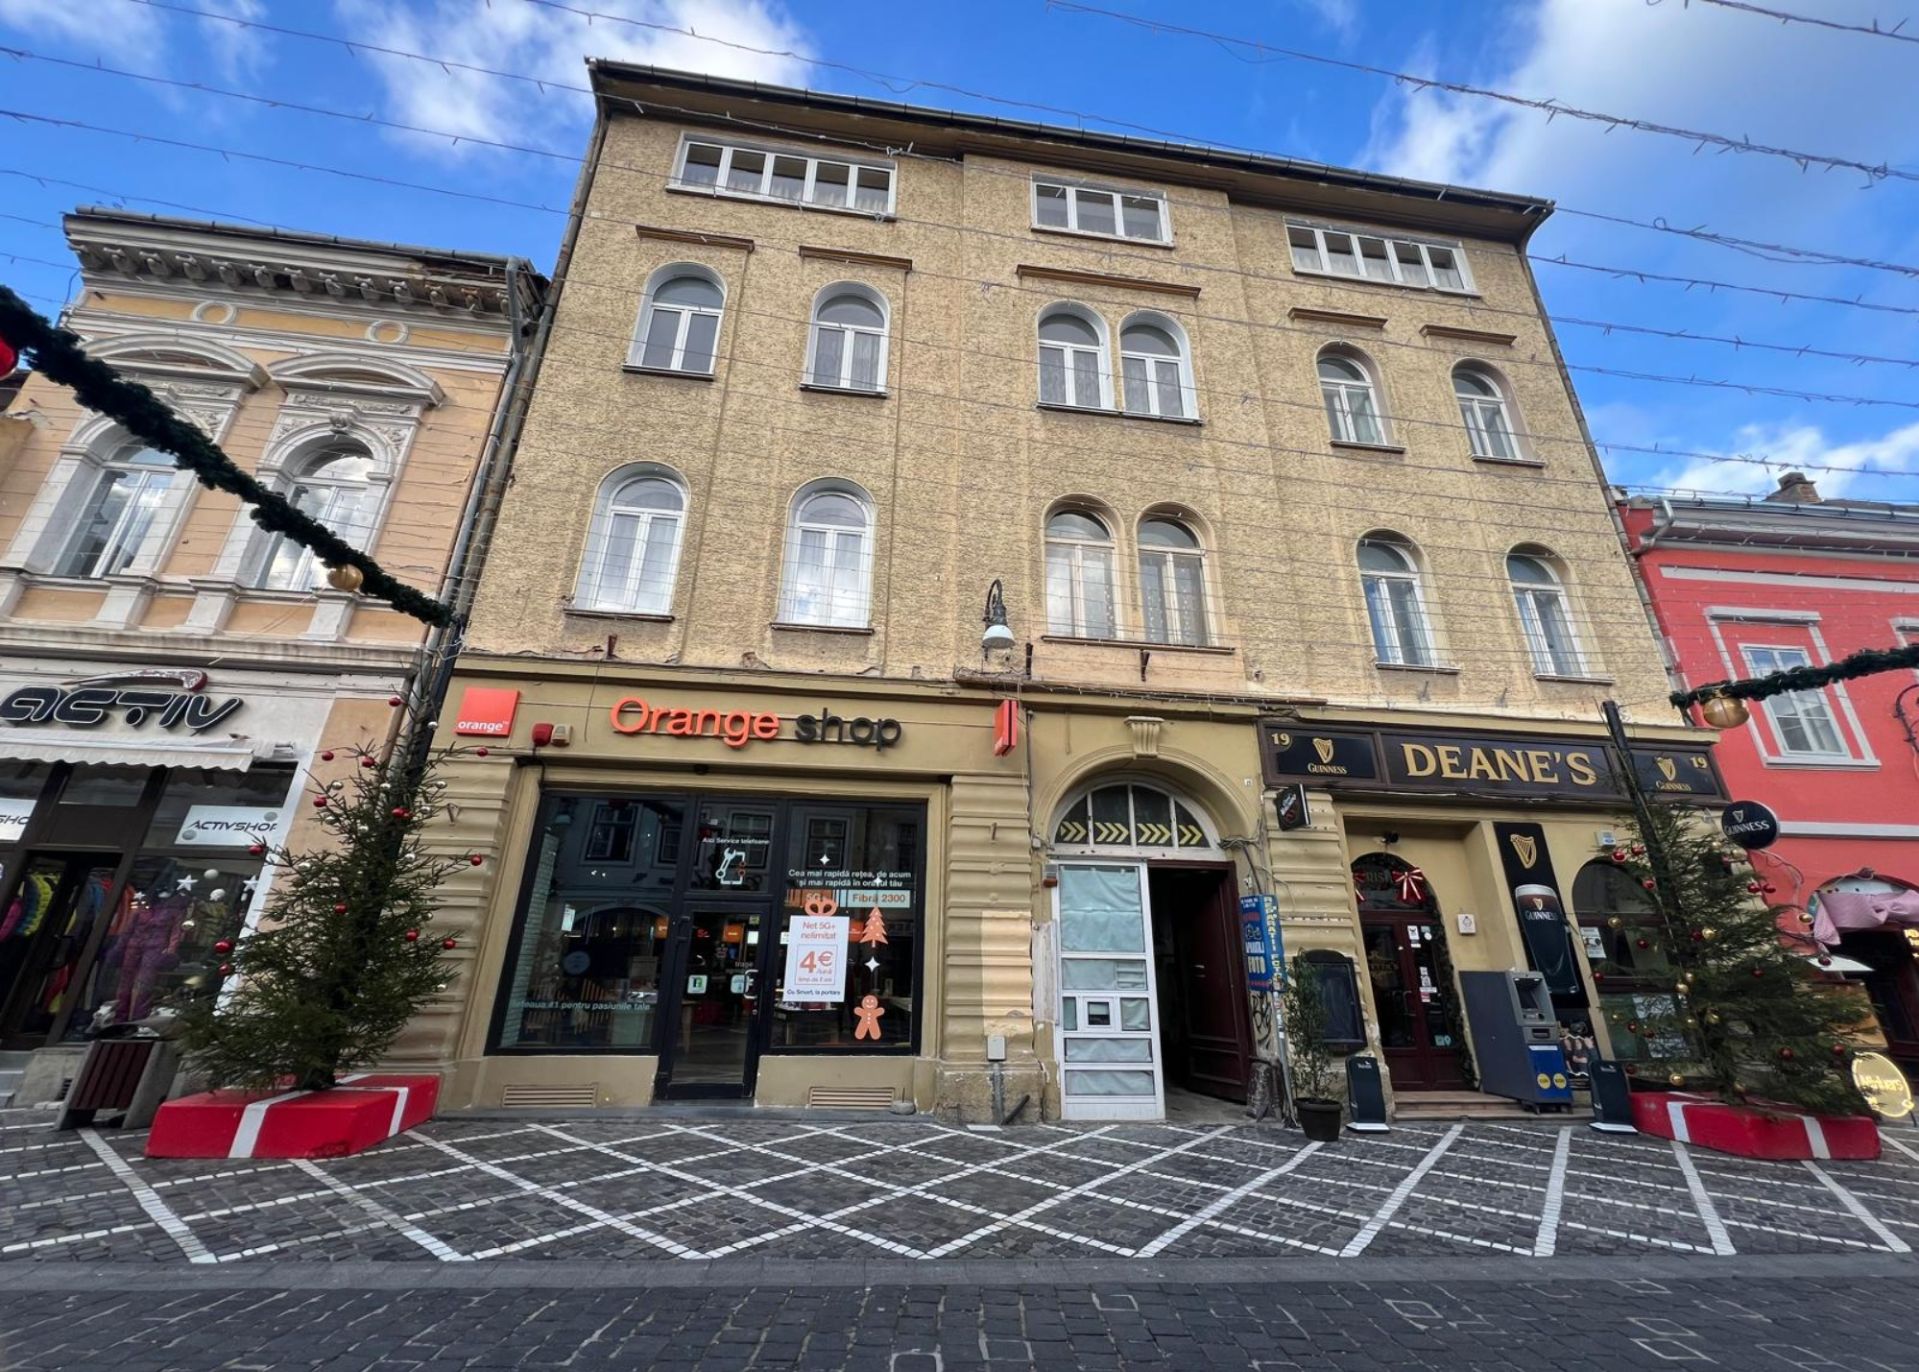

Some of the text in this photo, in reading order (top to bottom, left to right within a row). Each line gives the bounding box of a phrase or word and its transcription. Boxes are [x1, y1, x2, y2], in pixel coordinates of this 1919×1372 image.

[457, 721, 503, 733] orange
[610, 696, 903, 751] Orange shop
[1271, 732, 1290, 746] 19
[1307, 762, 1348, 775] GUINNESS
[1400, 743, 1597, 785] DEANE'S
[1690, 756, 1708, 769] 19
[1724, 820, 1770, 836] GUINNESS
[788, 868, 805, 877] Cea
[807, 870, 823, 878] mai
[877, 870, 888, 879] de
[808, 879, 823, 887] mai
[862, 879, 888, 889] oraul
[881, 893, 906, 904] 2300
[802, 921, 818, 930] Net
[561, 1001, 591, 1010] pentru
